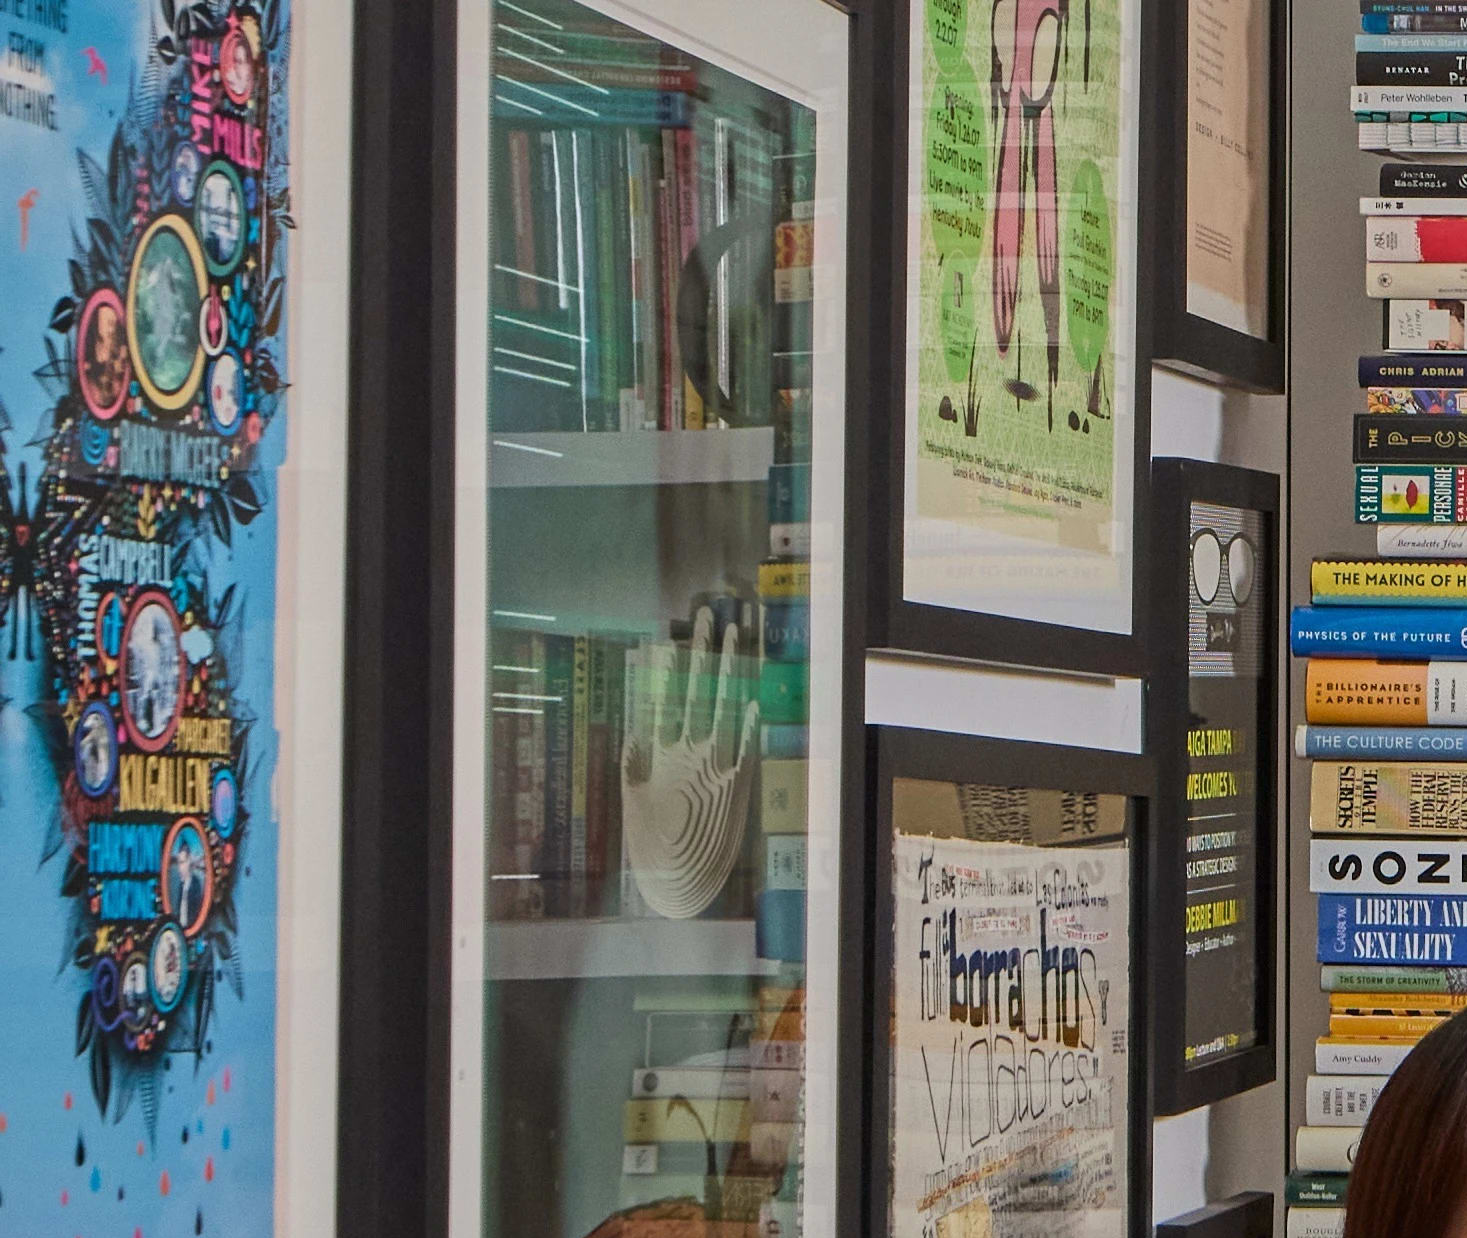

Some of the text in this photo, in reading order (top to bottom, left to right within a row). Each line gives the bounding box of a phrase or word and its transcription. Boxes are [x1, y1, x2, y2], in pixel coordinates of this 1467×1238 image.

[1369, 428, 1377, 448] THE
[1333, 573, 1362, 586] THE
[1365, 574, 1425, 587] MAKING
[1431, 575, 1454, 587] OF
[1315, 735, 1464, 750] THE CULTURE CODE
[1355, 898, 1435, 927] LIBERTY
[1353, 933, 1456, 961] SEXUALITY
